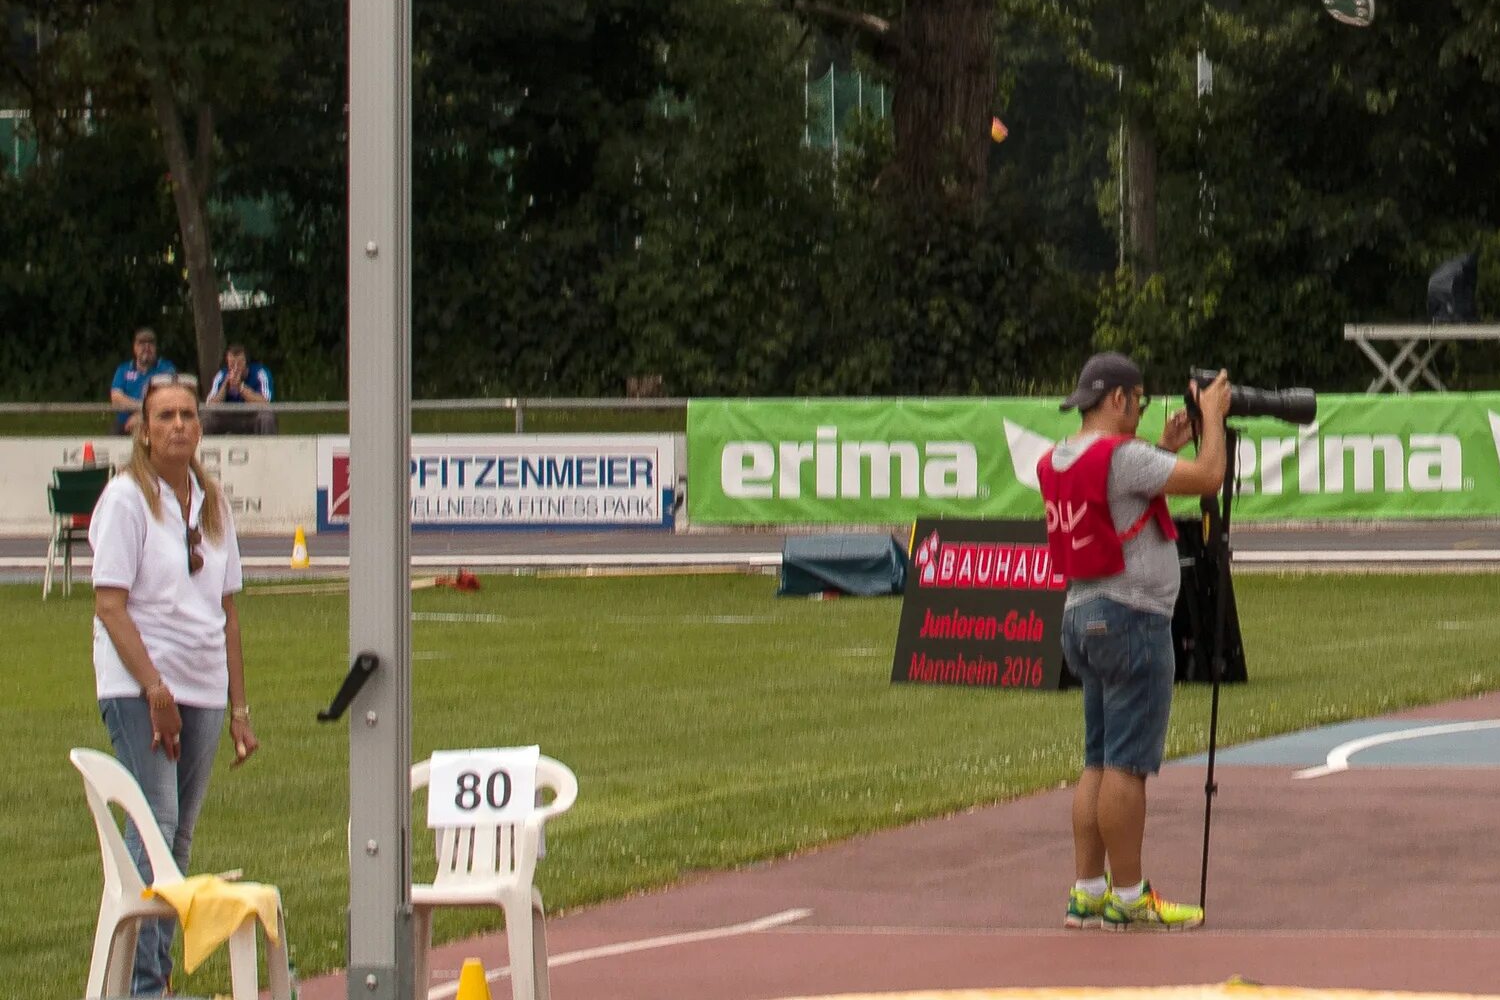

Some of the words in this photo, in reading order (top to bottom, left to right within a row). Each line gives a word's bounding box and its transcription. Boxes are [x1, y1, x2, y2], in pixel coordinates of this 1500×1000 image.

[721, 425, 978, 499] erima
[411, 495, 498, 517] ELLNESS
[519, 495, 598, 517] FITNESS
[603, 495, 652, 517] PARK
[940, 549, 1064, 584] BAUHAU
[919, 606, 1044, 642] Junioren-Gala
[908, 652, 998, 687] Mannheim
[1001, 656, 1043, 688] 2016
[455, 769, 512, 810] 80
